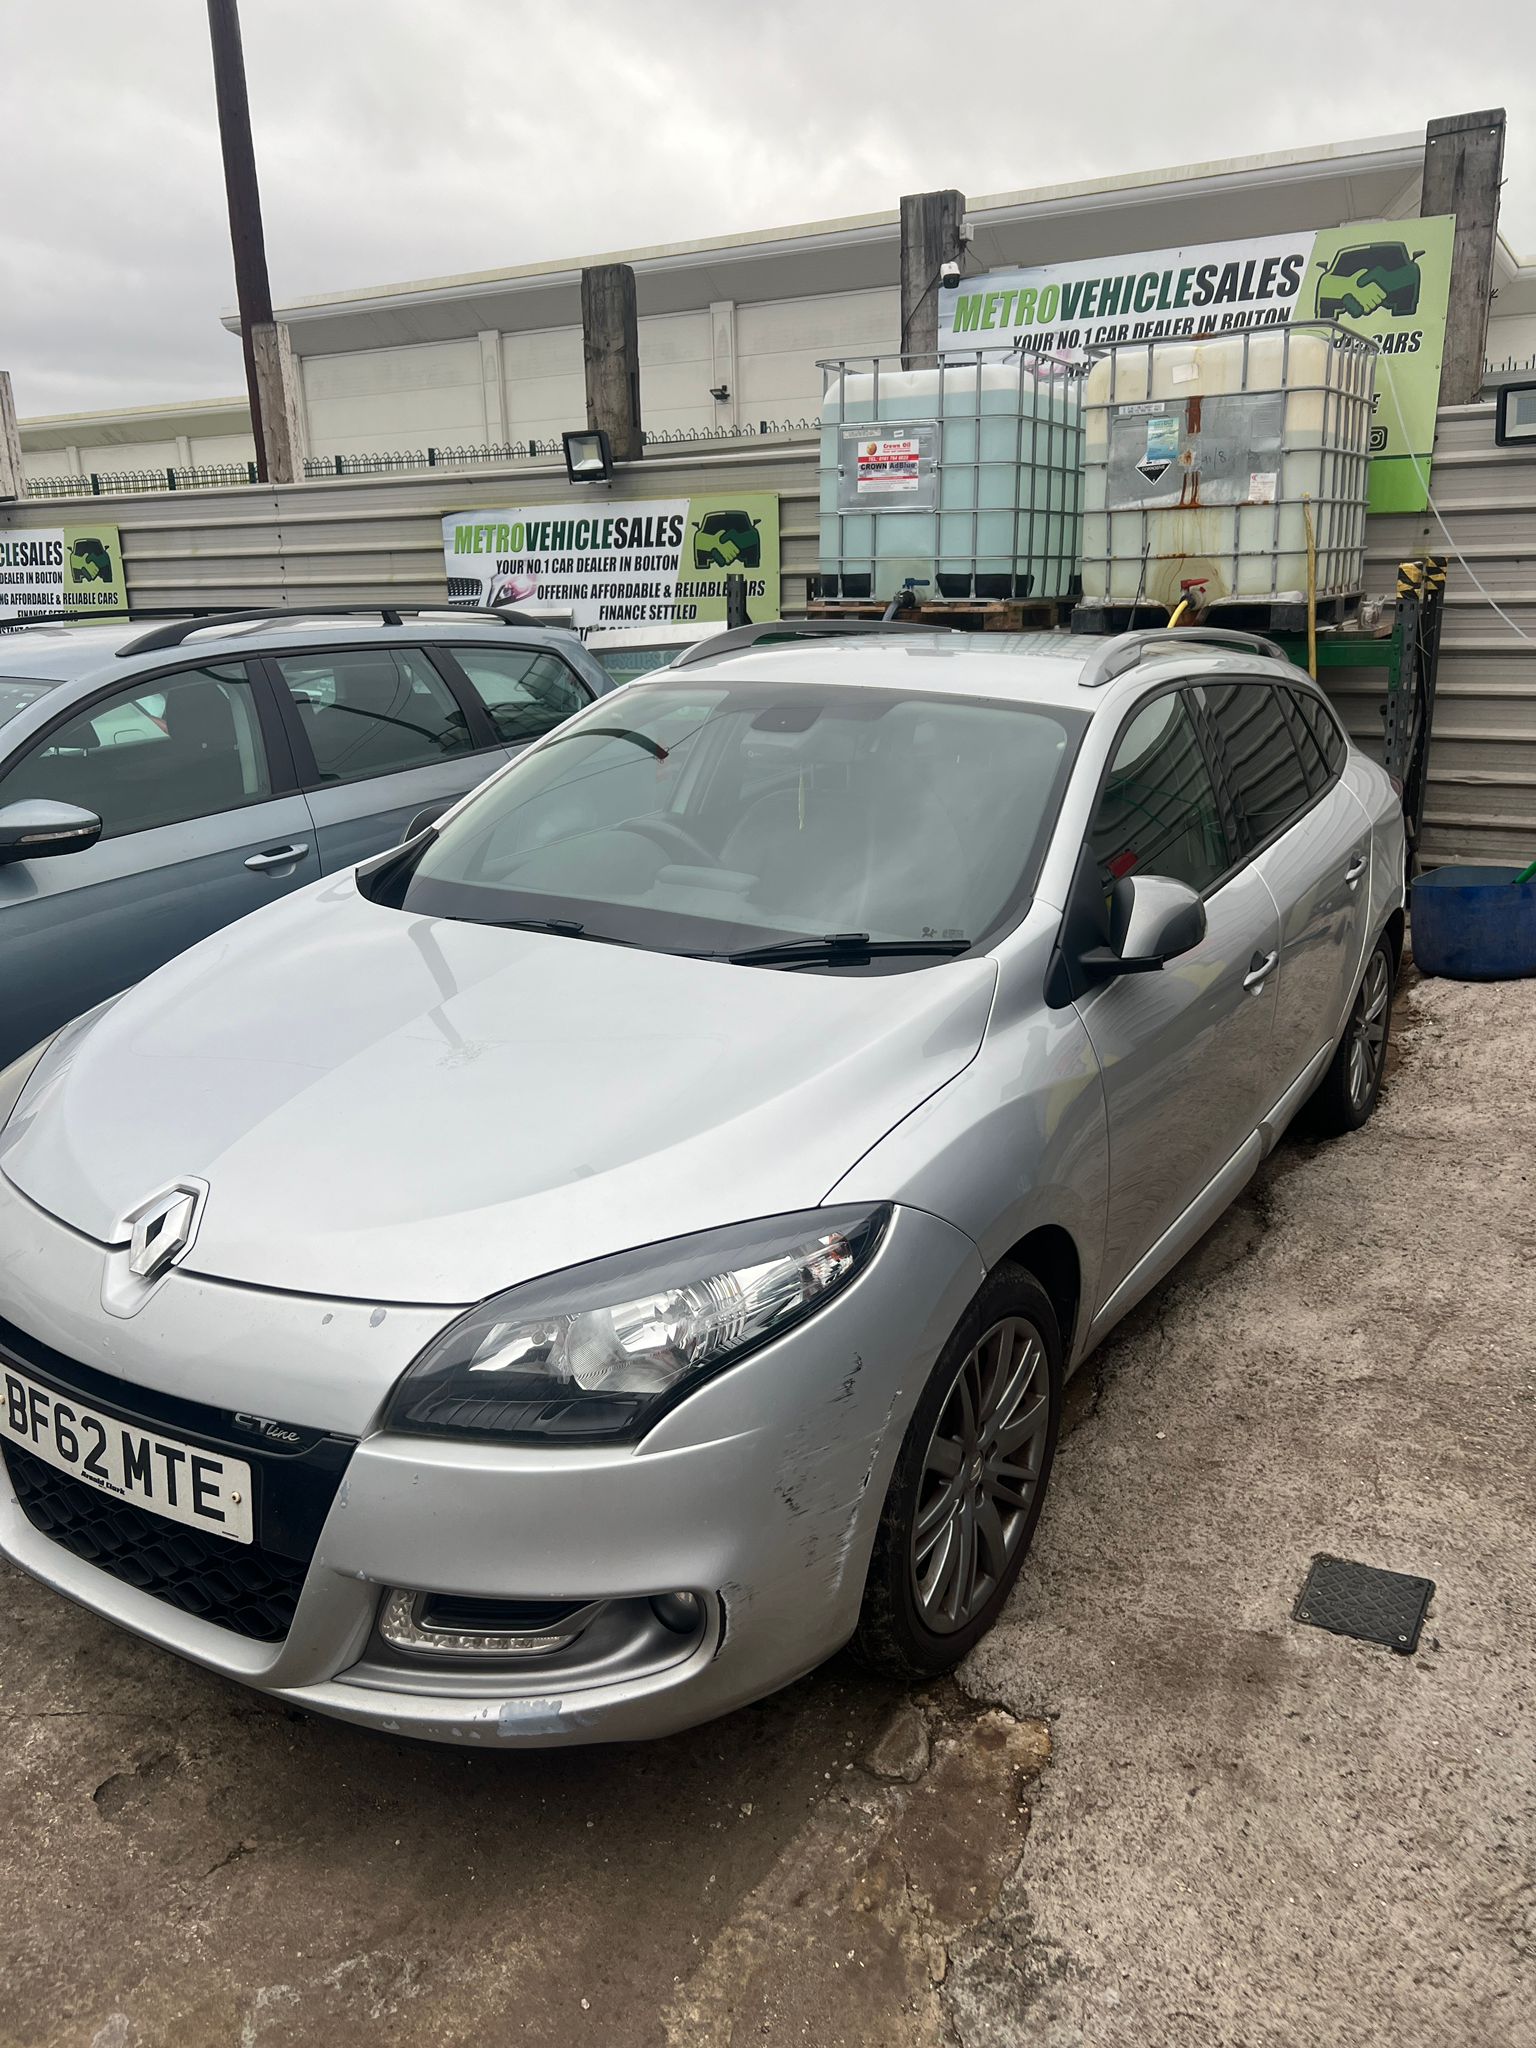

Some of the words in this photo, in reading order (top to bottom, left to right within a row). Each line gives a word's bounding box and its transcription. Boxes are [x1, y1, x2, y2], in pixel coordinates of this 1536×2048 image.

[953, 254, 1304, 333] METROVEHICLESALES
[1014, 332, 1055, 354] YOUR
[1057, 327, 1092, 350] NO.1
[1095, 324, 1129, 343] CAR
[1198, 313, 1218, 336] IN
[860, 463, 888, 471] CROWN
[454, 515, 684, 554] METROVEHICLESALES
[496, 559, 525, 575] YOUR
[526, 558, 550, 574] NO.1
[551, 557, 574, 573] CAR
[576, 556, 617, 573] DEALER
[619, 556, 632, 571] IN
[634, 554, 679, 571] BOLTON
[26, 572, 34, 584] IN
[35, 571, 63, 584] BOLTON
[10, 593, 55, 605] AFFORDABLE
[55, 594, 61, 605] &
[62, 592, 96, 605] RELIABLE
[97, 592, 119, 605] CARS
[537, 583, 588, 600] OFFERING
[590, 582, 661, 599] AFFORDABLE
[663, 584, 672, 598] &
[599, 605, 647, 621] FINANCE
[648, 604, 697, 620] SETTLED
[5, 1373, 109, 1479] BF62
[121, 1430, 226, 1523] MTE
